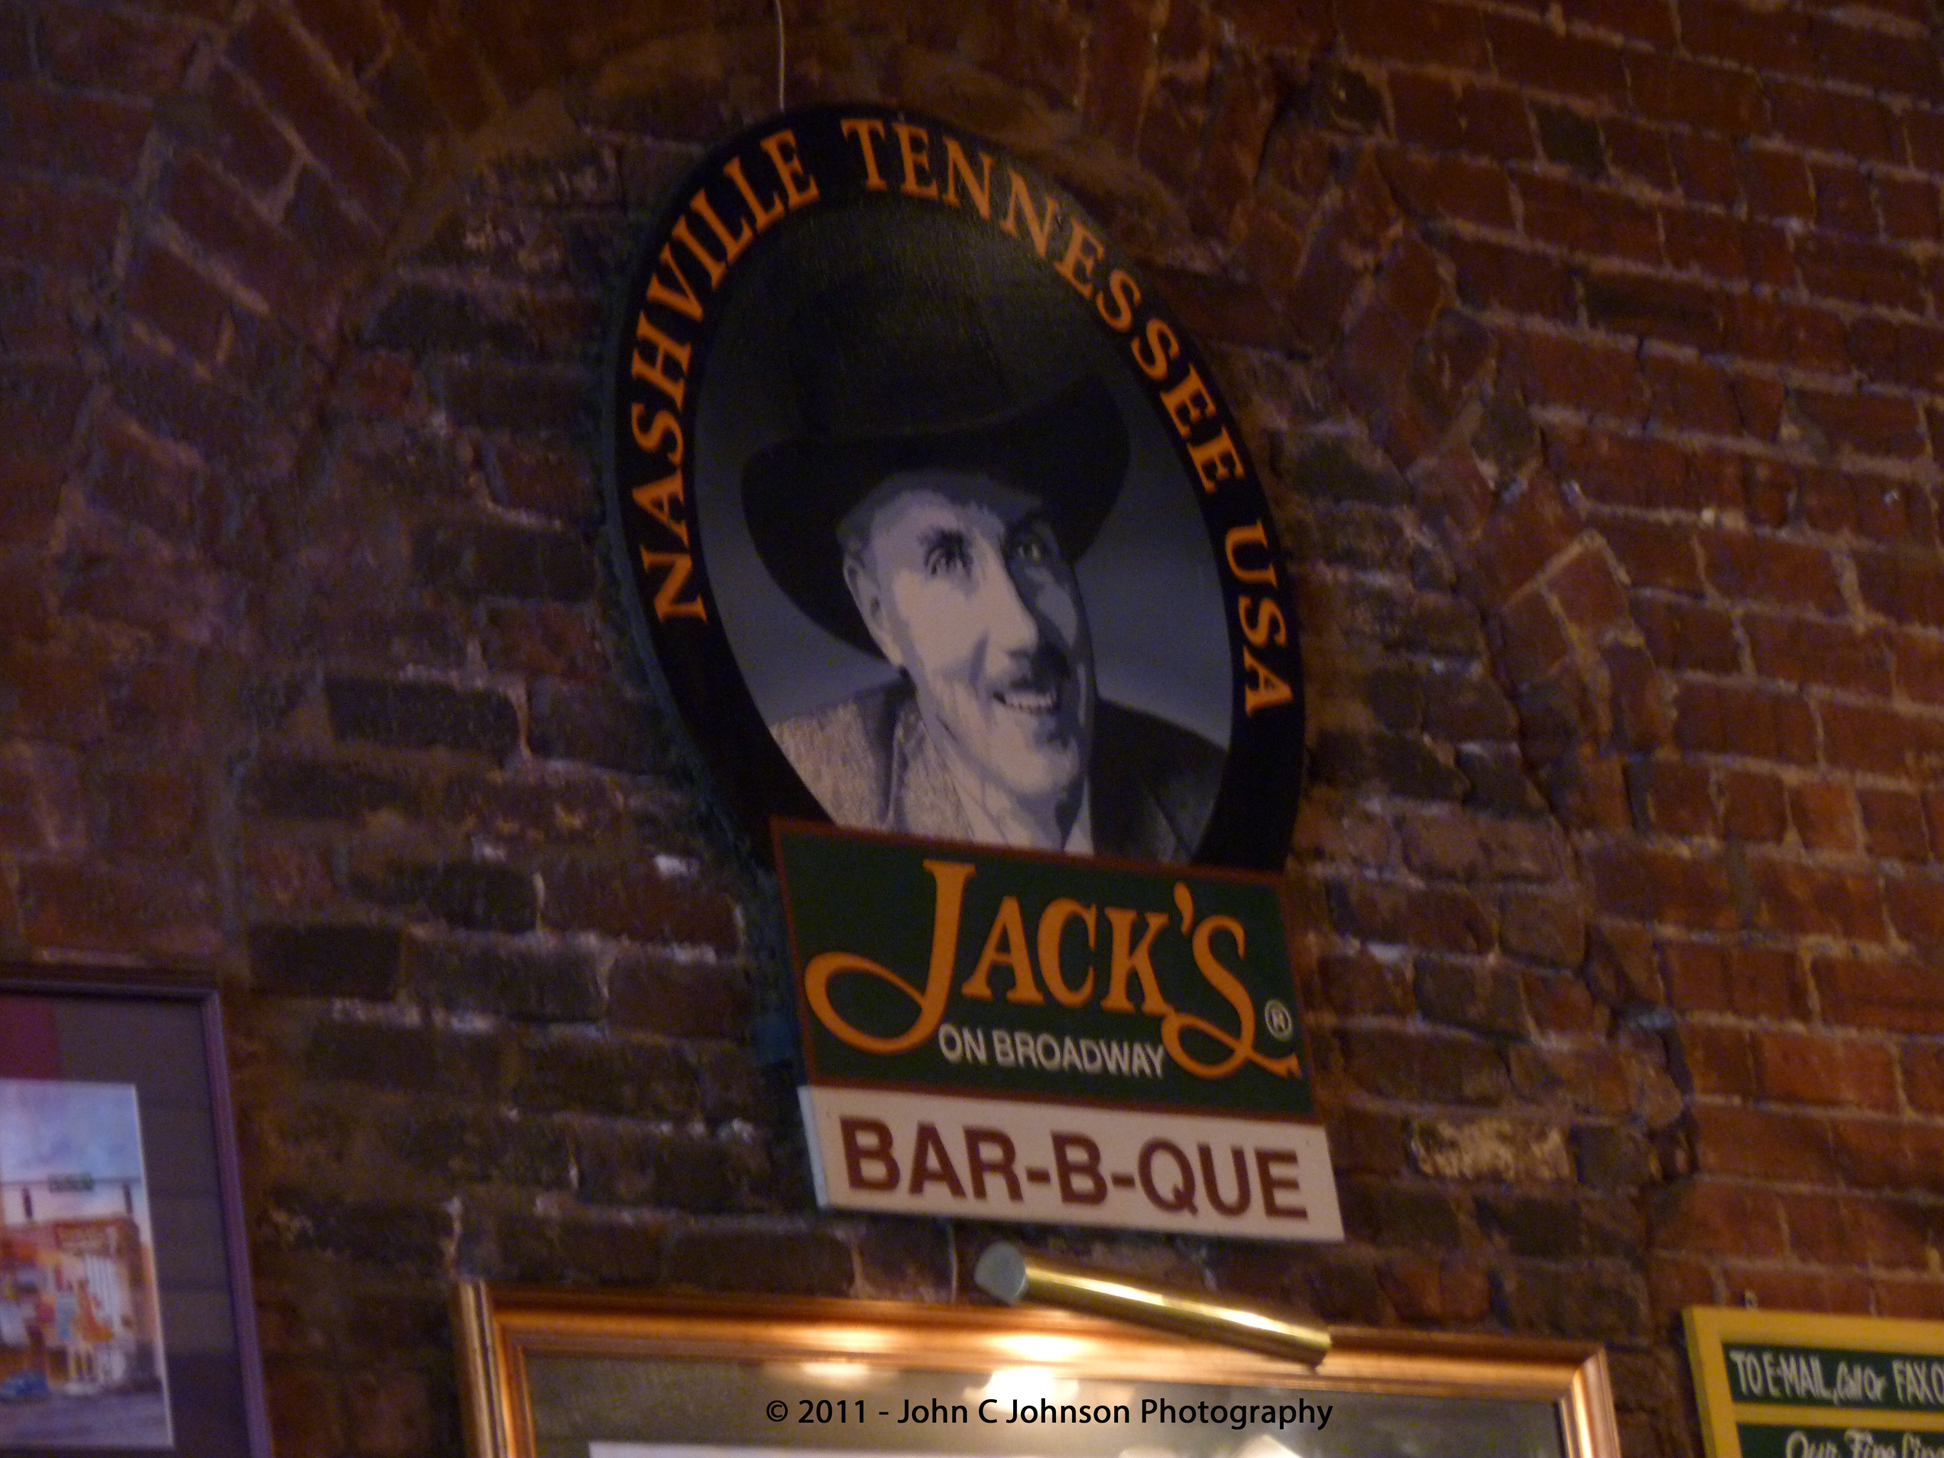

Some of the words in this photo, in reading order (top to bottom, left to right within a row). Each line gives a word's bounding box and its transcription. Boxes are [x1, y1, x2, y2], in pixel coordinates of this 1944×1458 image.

[631, 128, 820, 624] NASHVILLE
[841, 117, 1245, 494] TENNESSEE
[1224, 519, 1293, 718] USA
[804, 859, 1301, 1079] JACK'S
[938, 1022, 987, 1065] ON
[992, 1028, 1165, 1079] BROADWAY
[839, 1115, 1308, 1222] BAR-B-QUE
